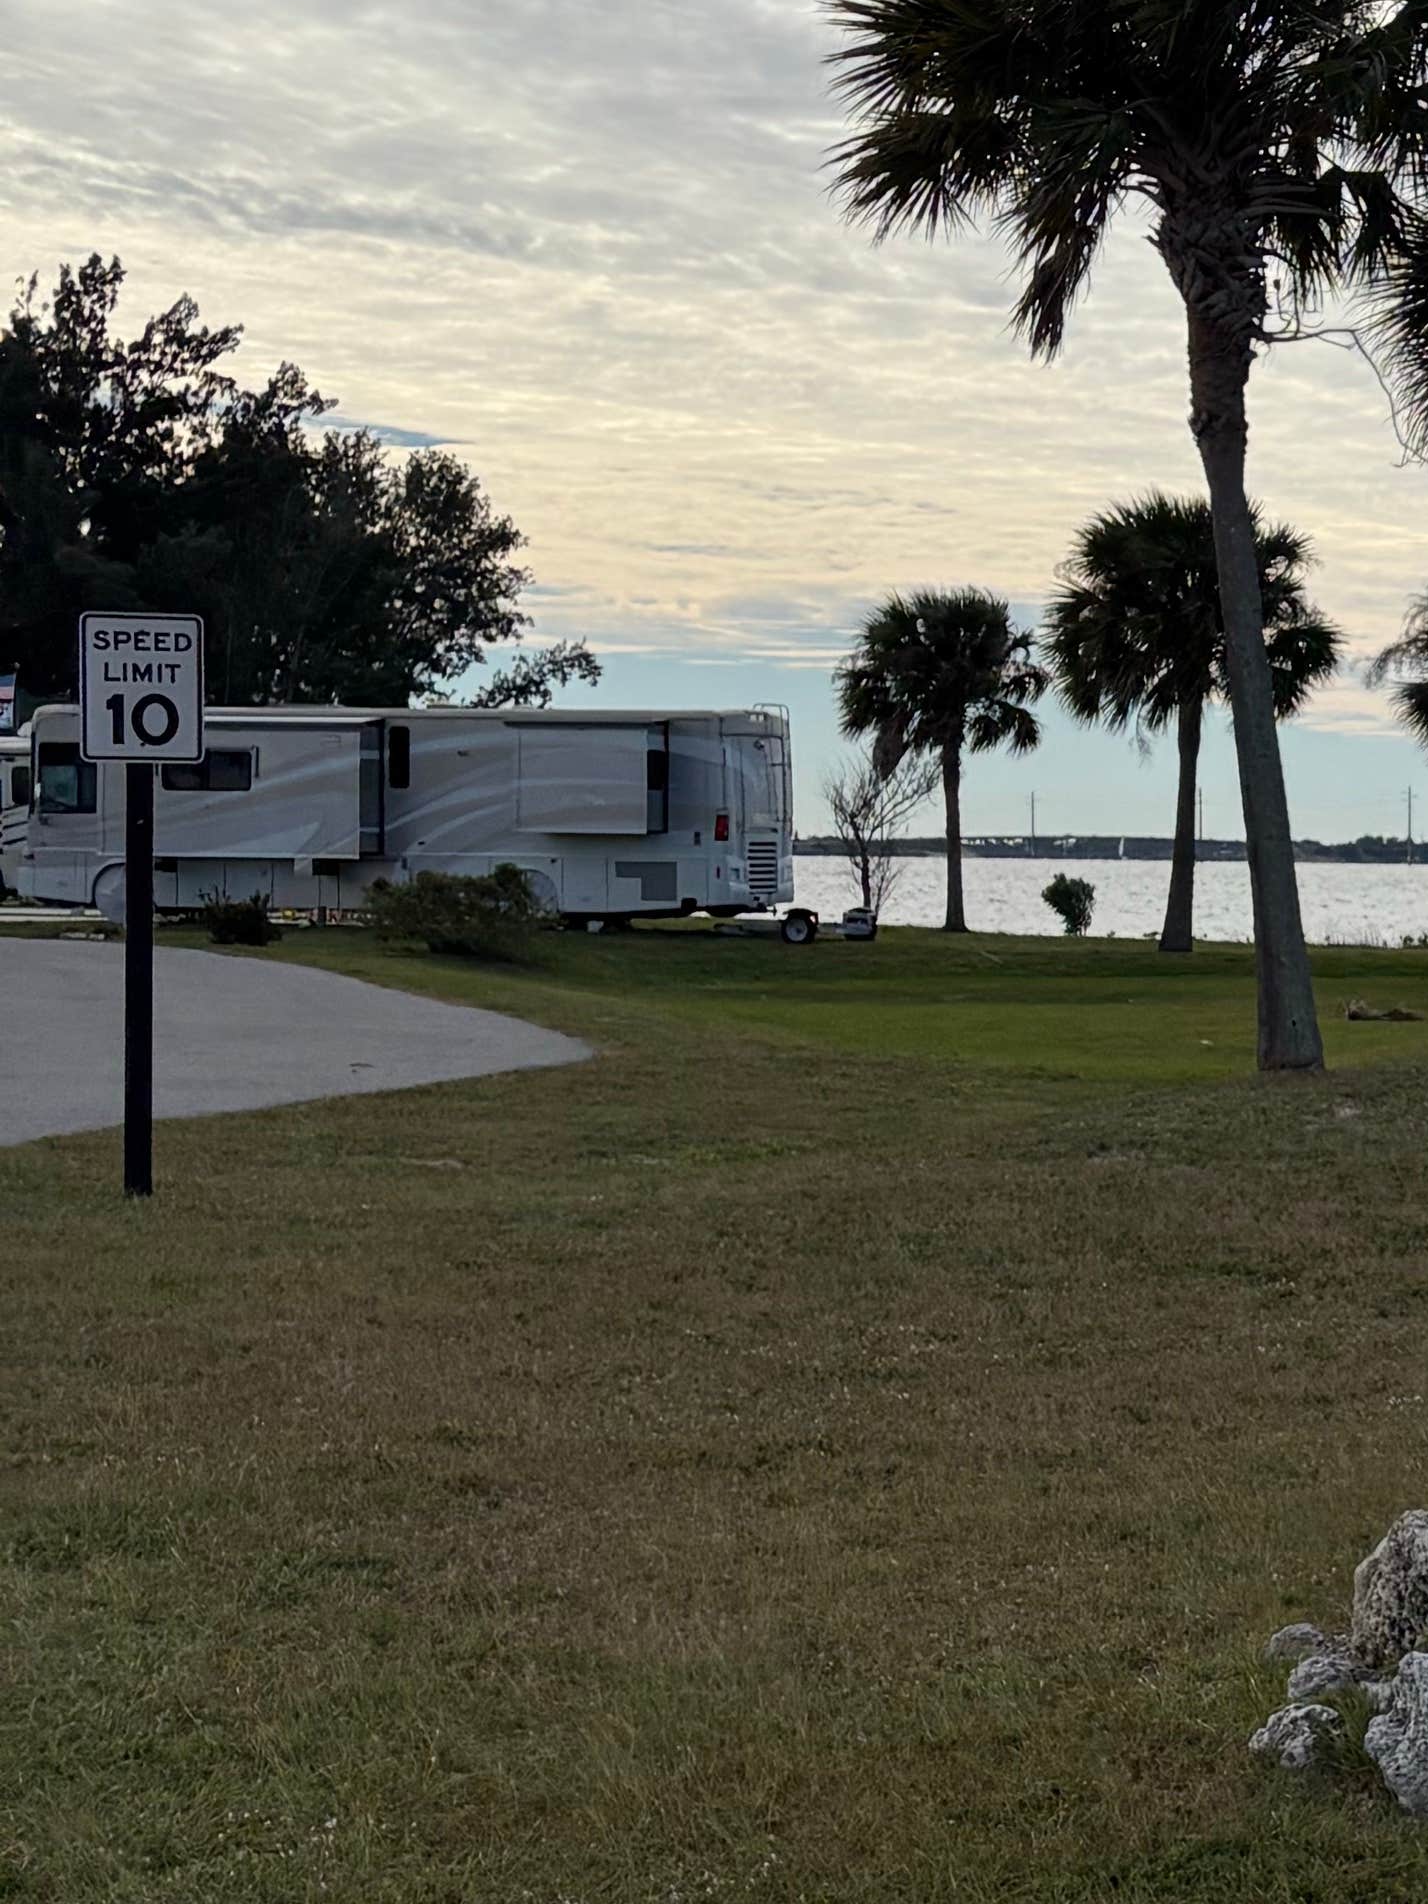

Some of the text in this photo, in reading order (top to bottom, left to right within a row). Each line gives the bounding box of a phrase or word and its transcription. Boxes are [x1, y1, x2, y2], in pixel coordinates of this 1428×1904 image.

[92, 629, 193, 653] SPEED
[103, 661, 182, 684] LIMIT
[105, 693, 180, 747] 10
